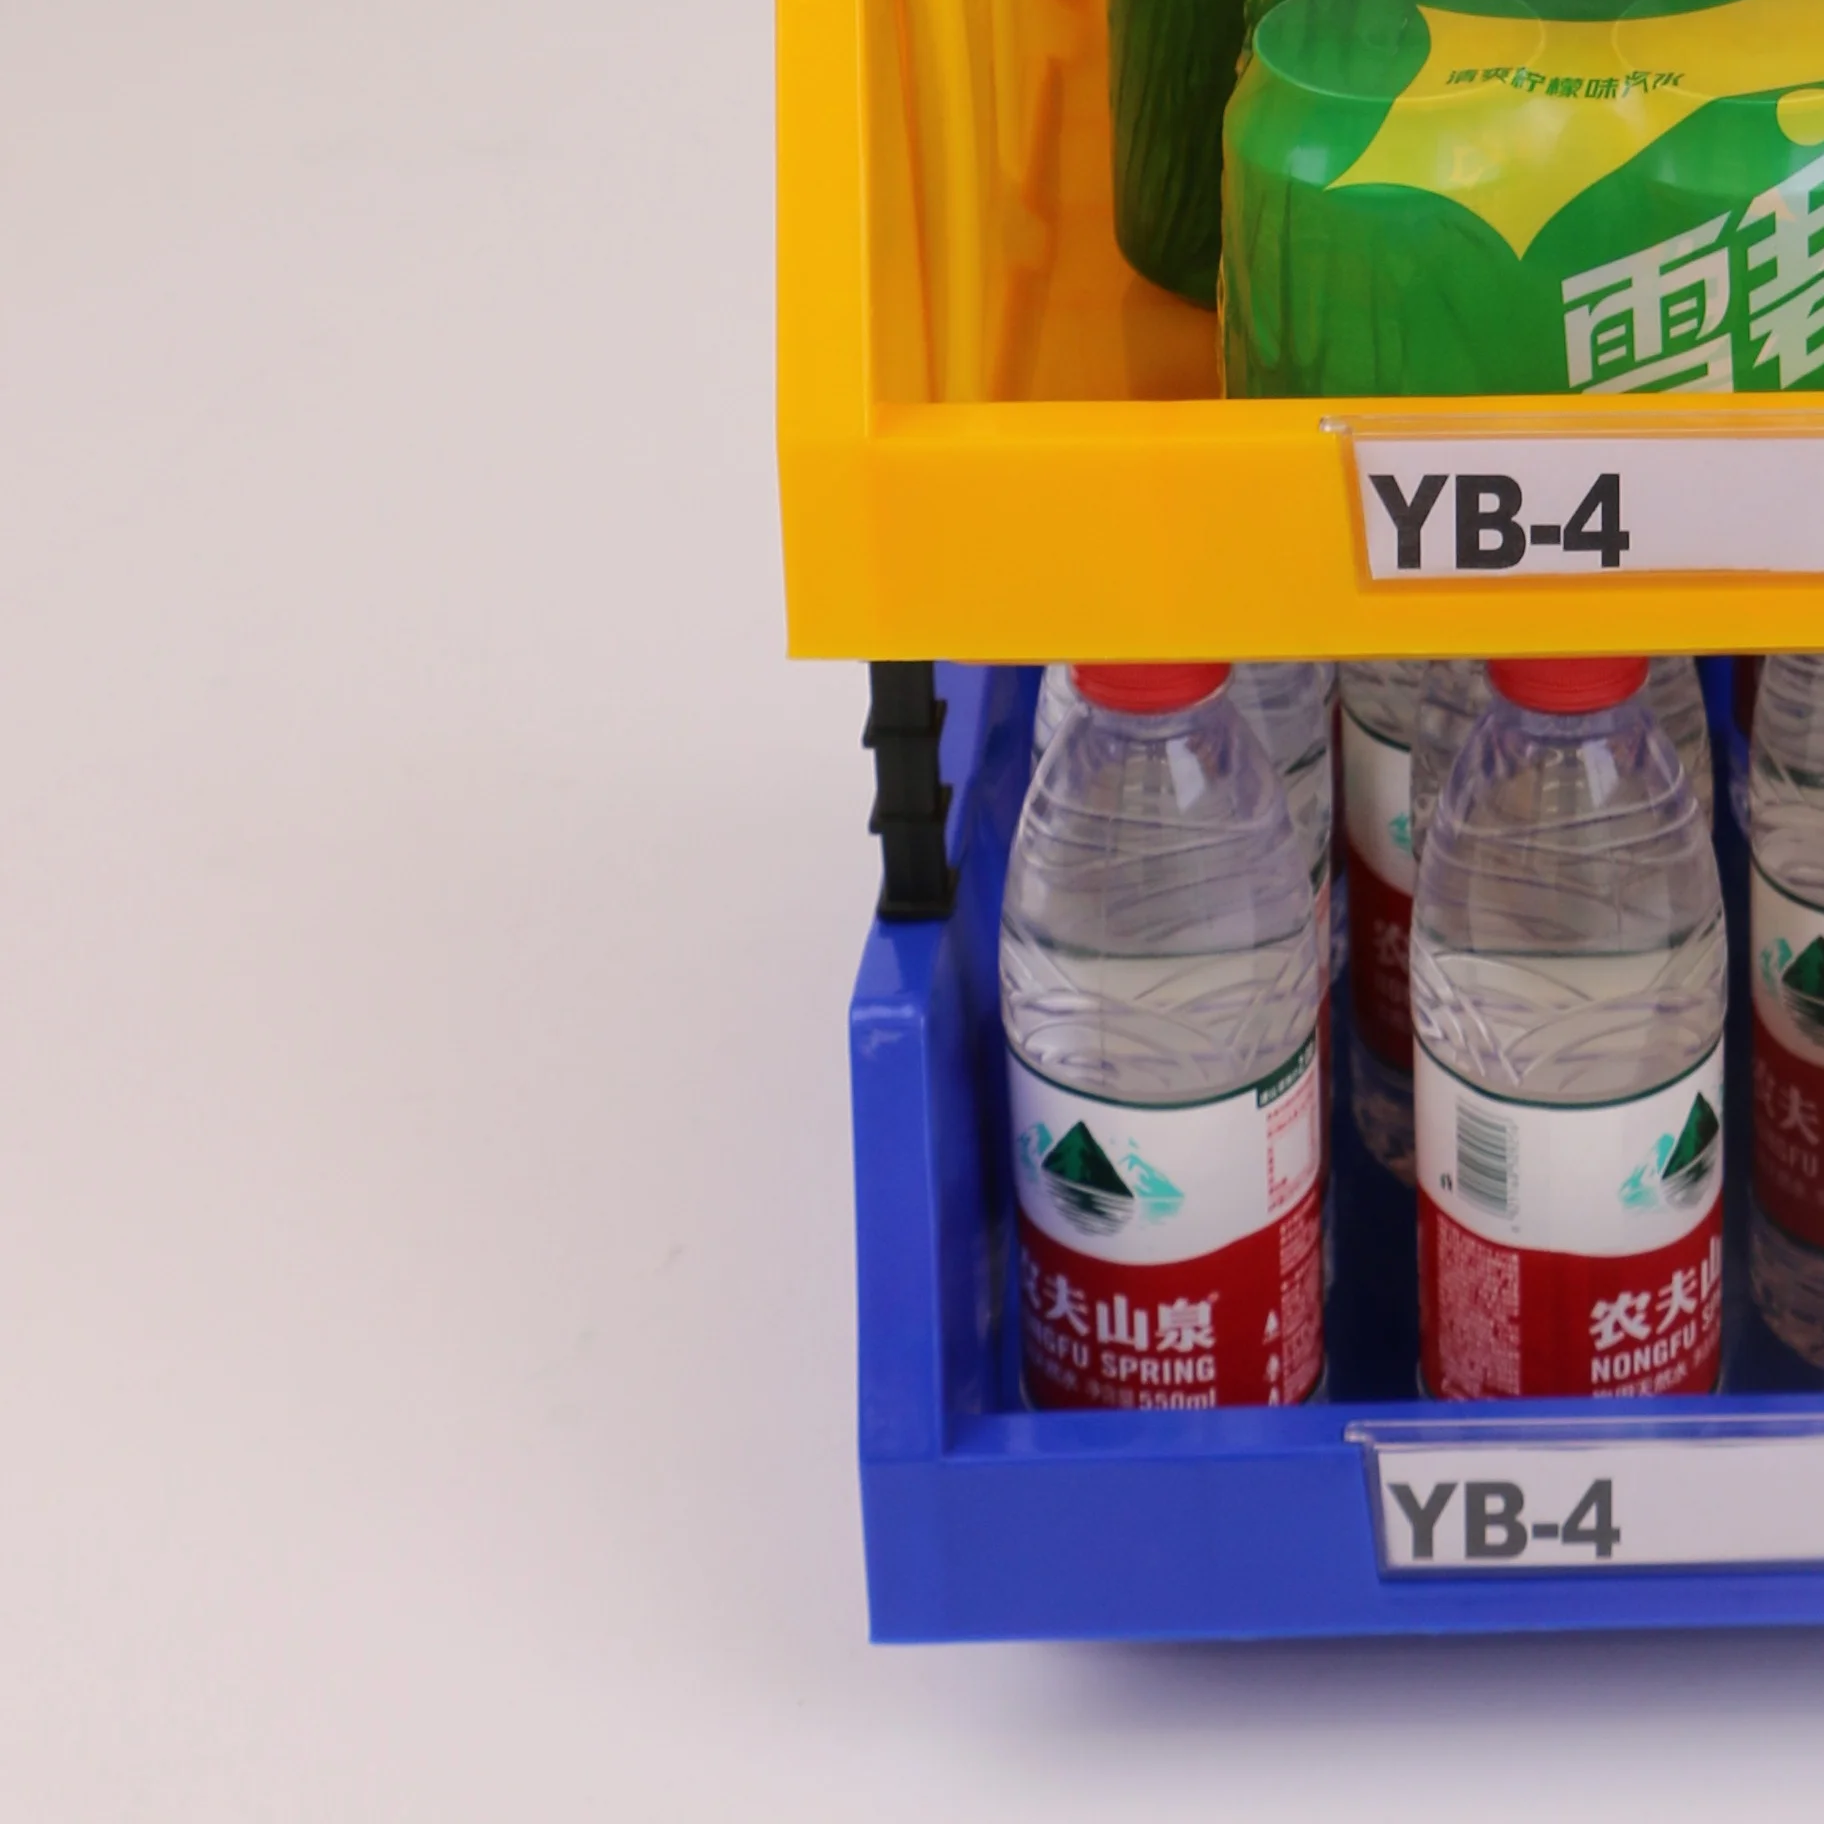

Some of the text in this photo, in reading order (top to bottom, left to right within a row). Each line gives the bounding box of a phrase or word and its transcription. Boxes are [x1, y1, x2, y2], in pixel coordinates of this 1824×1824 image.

[1446, 66, 1686, 100] 清爽柠檬味汽水
[1368, 474, 1630, 570] YB-4
[1101, 1350, 1216, 1385] SPRING
[1590, 1318, 1697, 1385] NONGFU
[1388, 1479, 1622, 1559] YB-4
